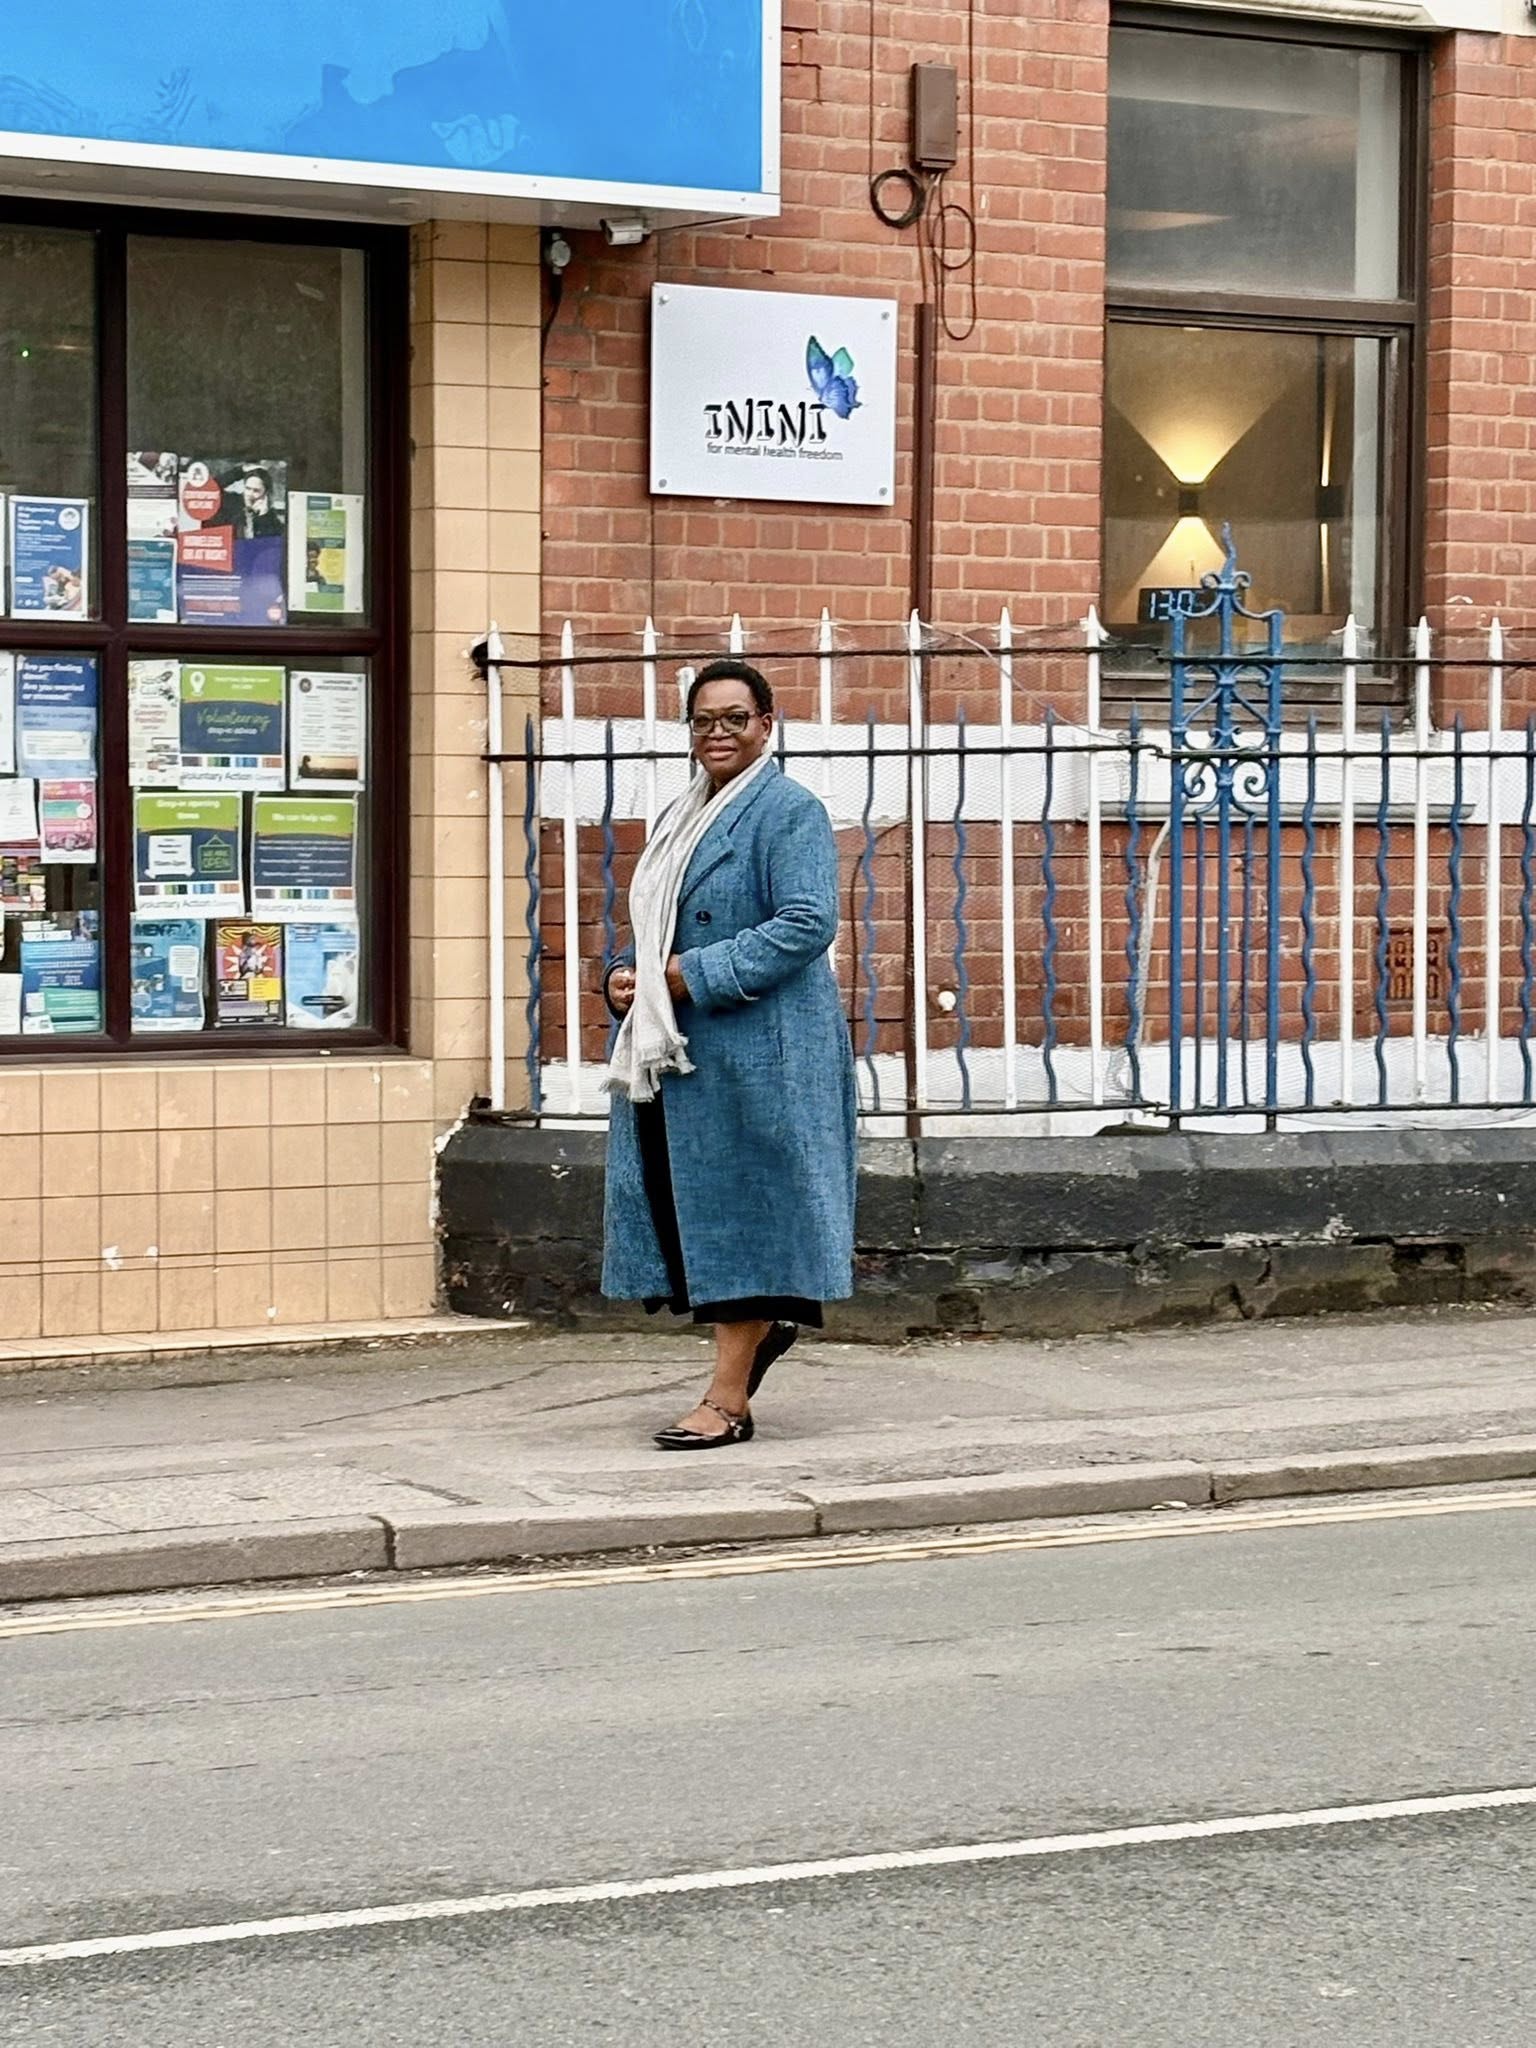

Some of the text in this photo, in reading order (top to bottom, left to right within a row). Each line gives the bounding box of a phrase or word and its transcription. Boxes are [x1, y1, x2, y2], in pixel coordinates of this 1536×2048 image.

[704, 398, 828, 446] ININI
[707, 442, 843, 460] for mental health freedom
